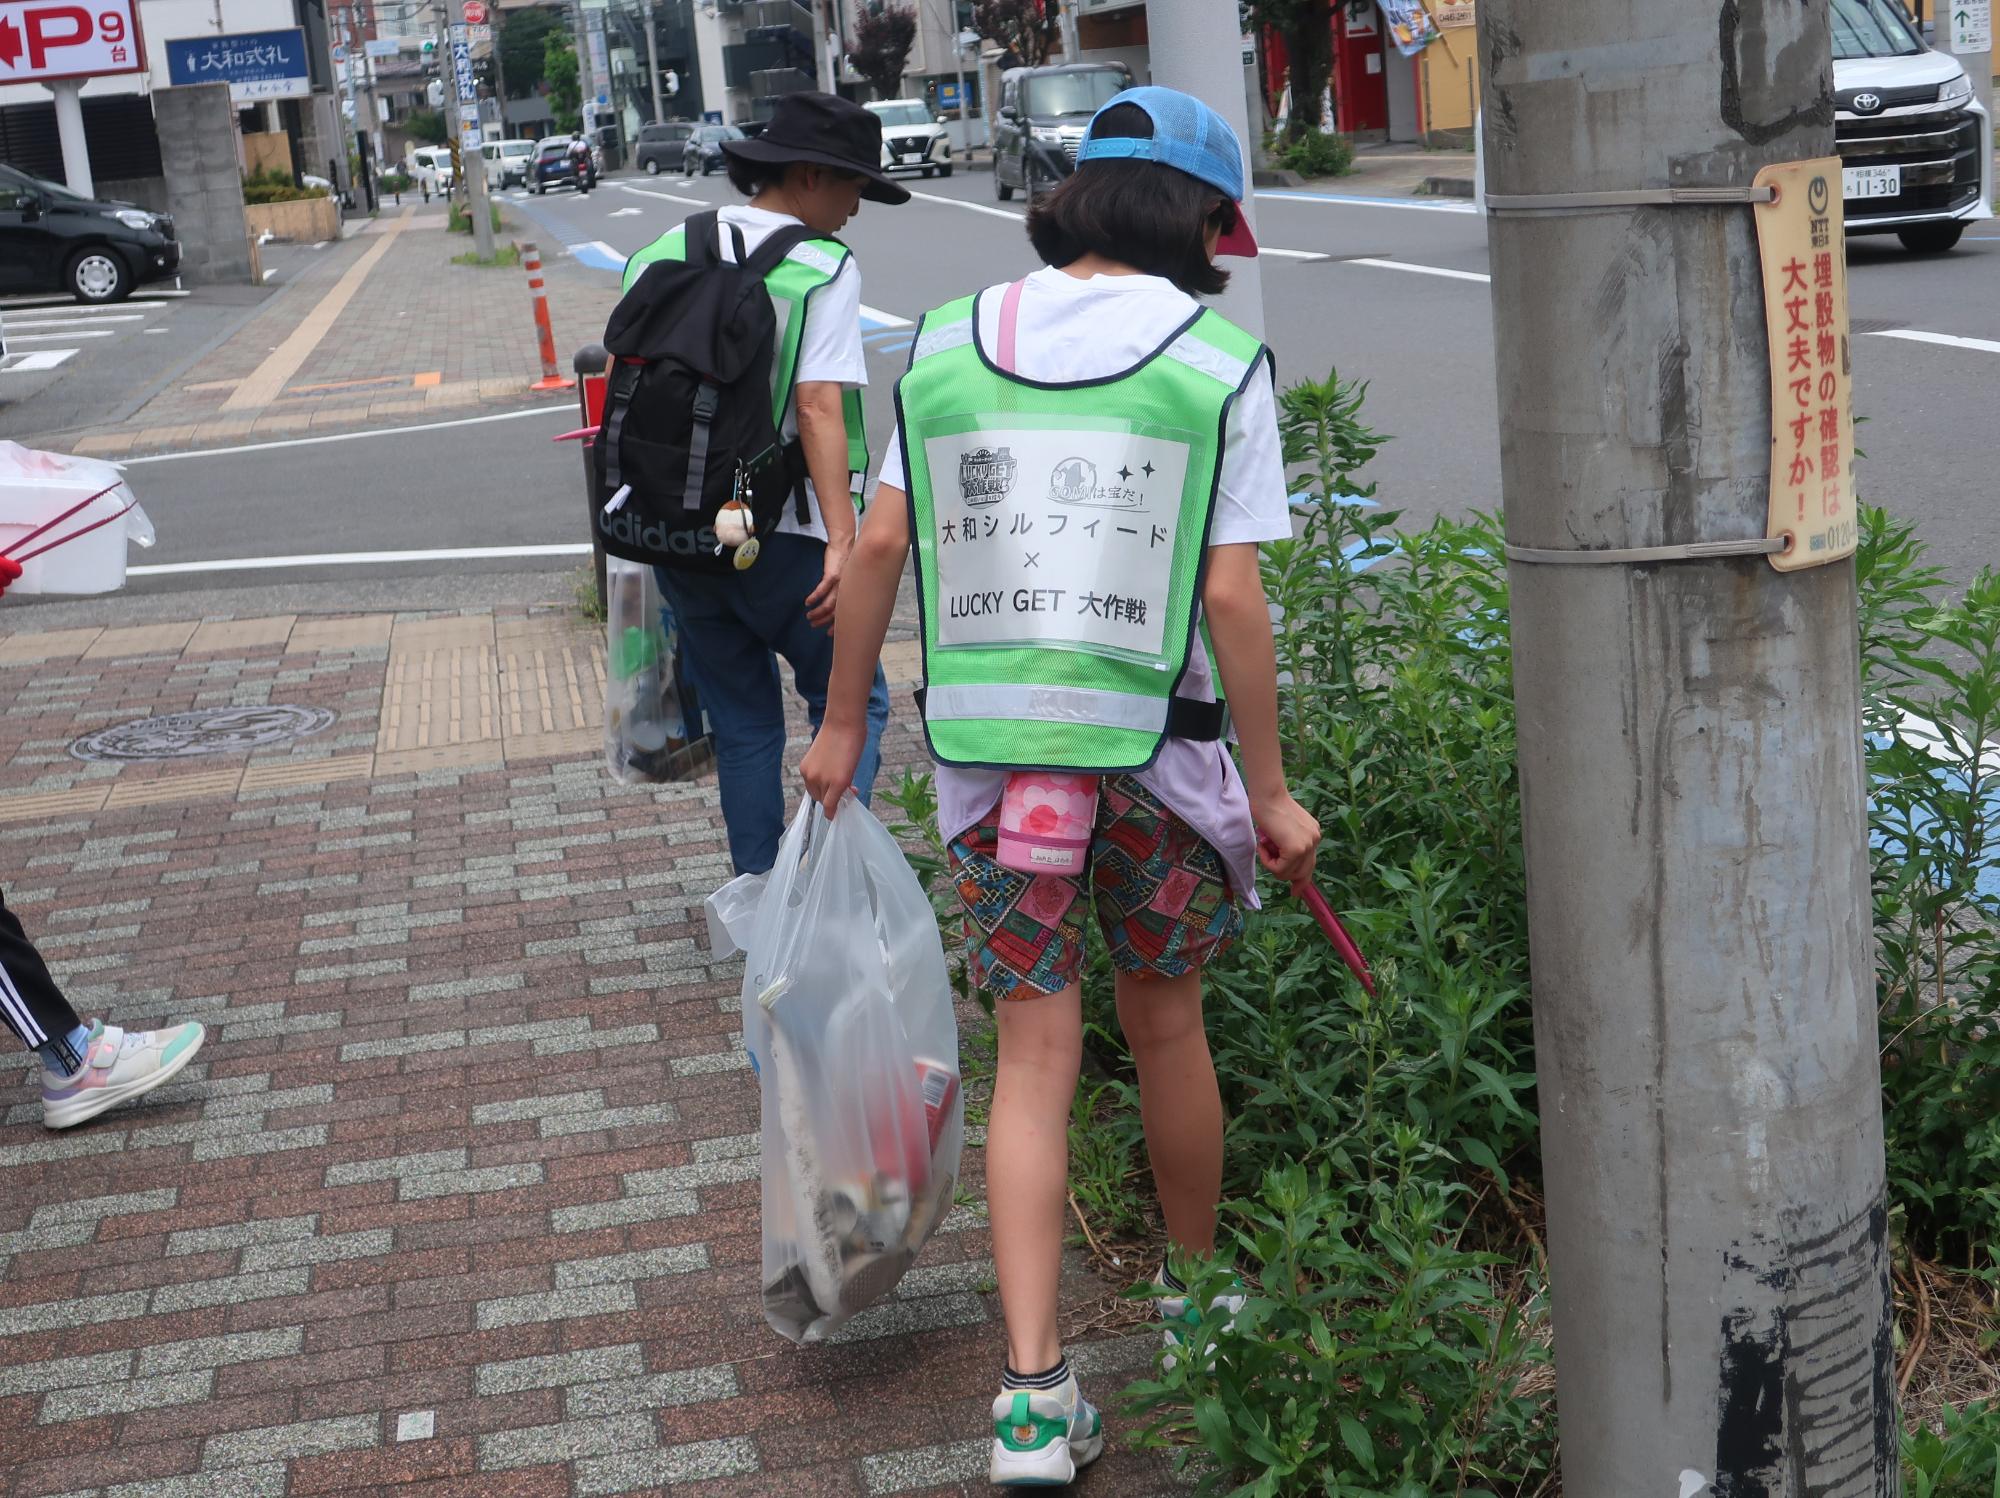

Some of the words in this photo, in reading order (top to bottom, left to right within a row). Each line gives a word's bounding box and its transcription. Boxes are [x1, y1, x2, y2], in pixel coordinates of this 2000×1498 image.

[24, 6, 94, 69] P
[99, 11, 125, 42] 9
[110, 45, 127, 63] 台
[200, 44, 290, 71] 大和式礼
[1857, 178, 1897, 196] 11-30
[1811, 217, 1829, 233] NTT
[1811, 233, 1829, 250] 東日本
[1782, 256, 1814, 521] 大丈夫ですか！
[1813, 253, 1841, 517] 埋設物の確認は
[600, 508, 716, 555] adidas
[942, 512, 1168, 549] 大和シルフィード
[950, 590, 1004, 619] LUCKY
[1013, 589, 1066, 612] GET
[1077, 591, 1147, 625] 大作戦
